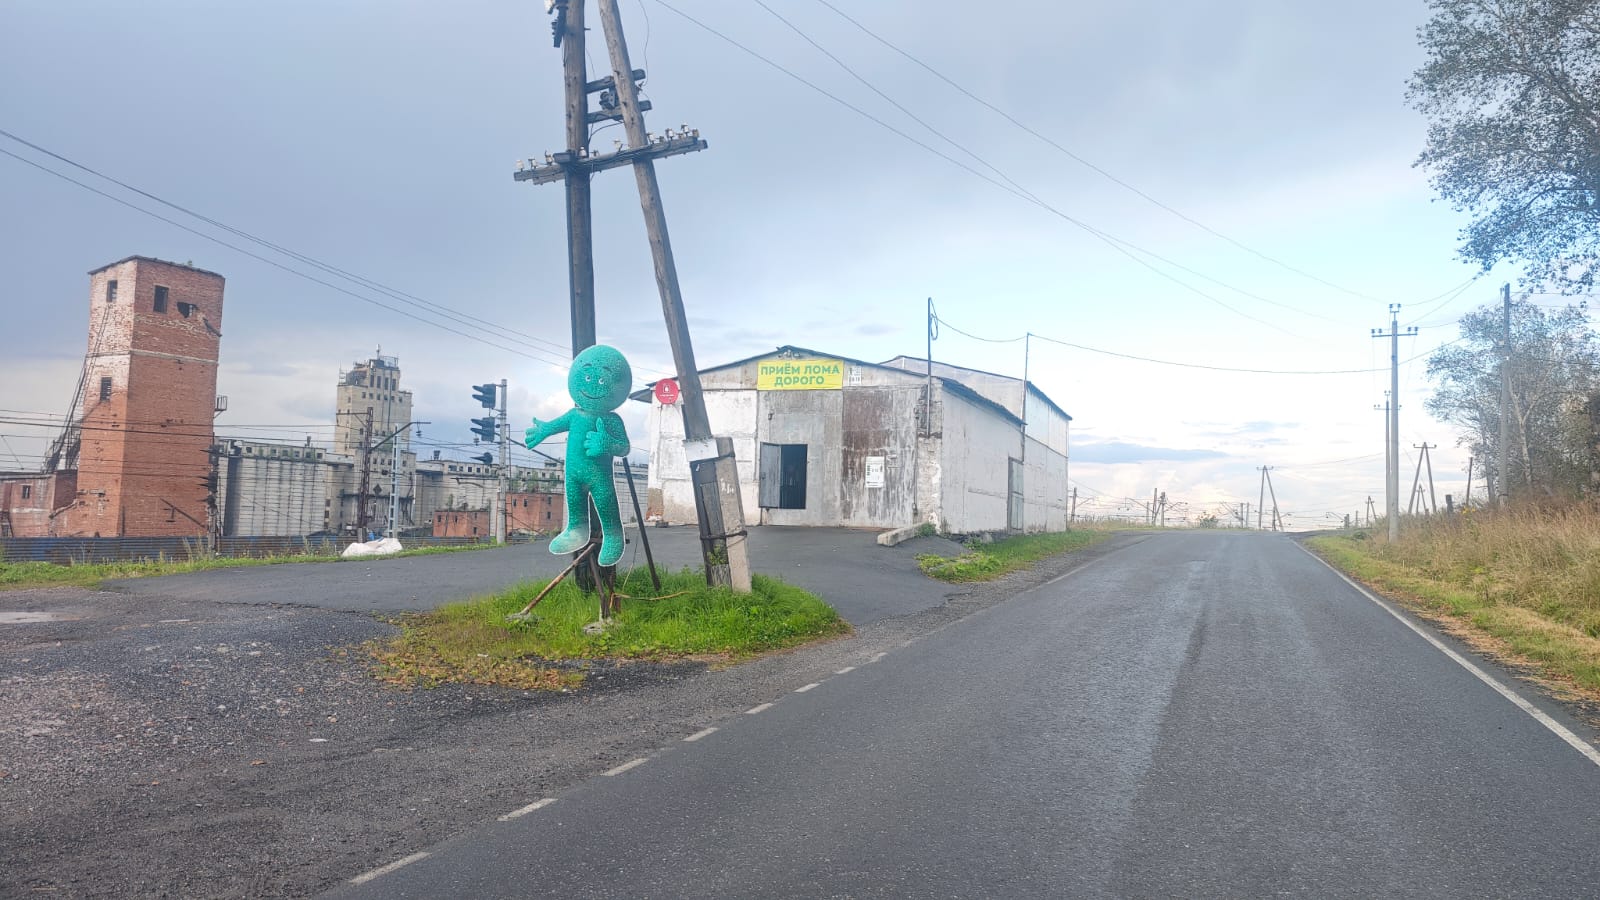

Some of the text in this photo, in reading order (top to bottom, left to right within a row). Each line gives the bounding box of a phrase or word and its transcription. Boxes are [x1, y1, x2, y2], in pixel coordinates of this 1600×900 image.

[761, 363, 840, 375] ПРИЁМ ЛОМА
[774, 376, 825, 387] ДОРОГО
